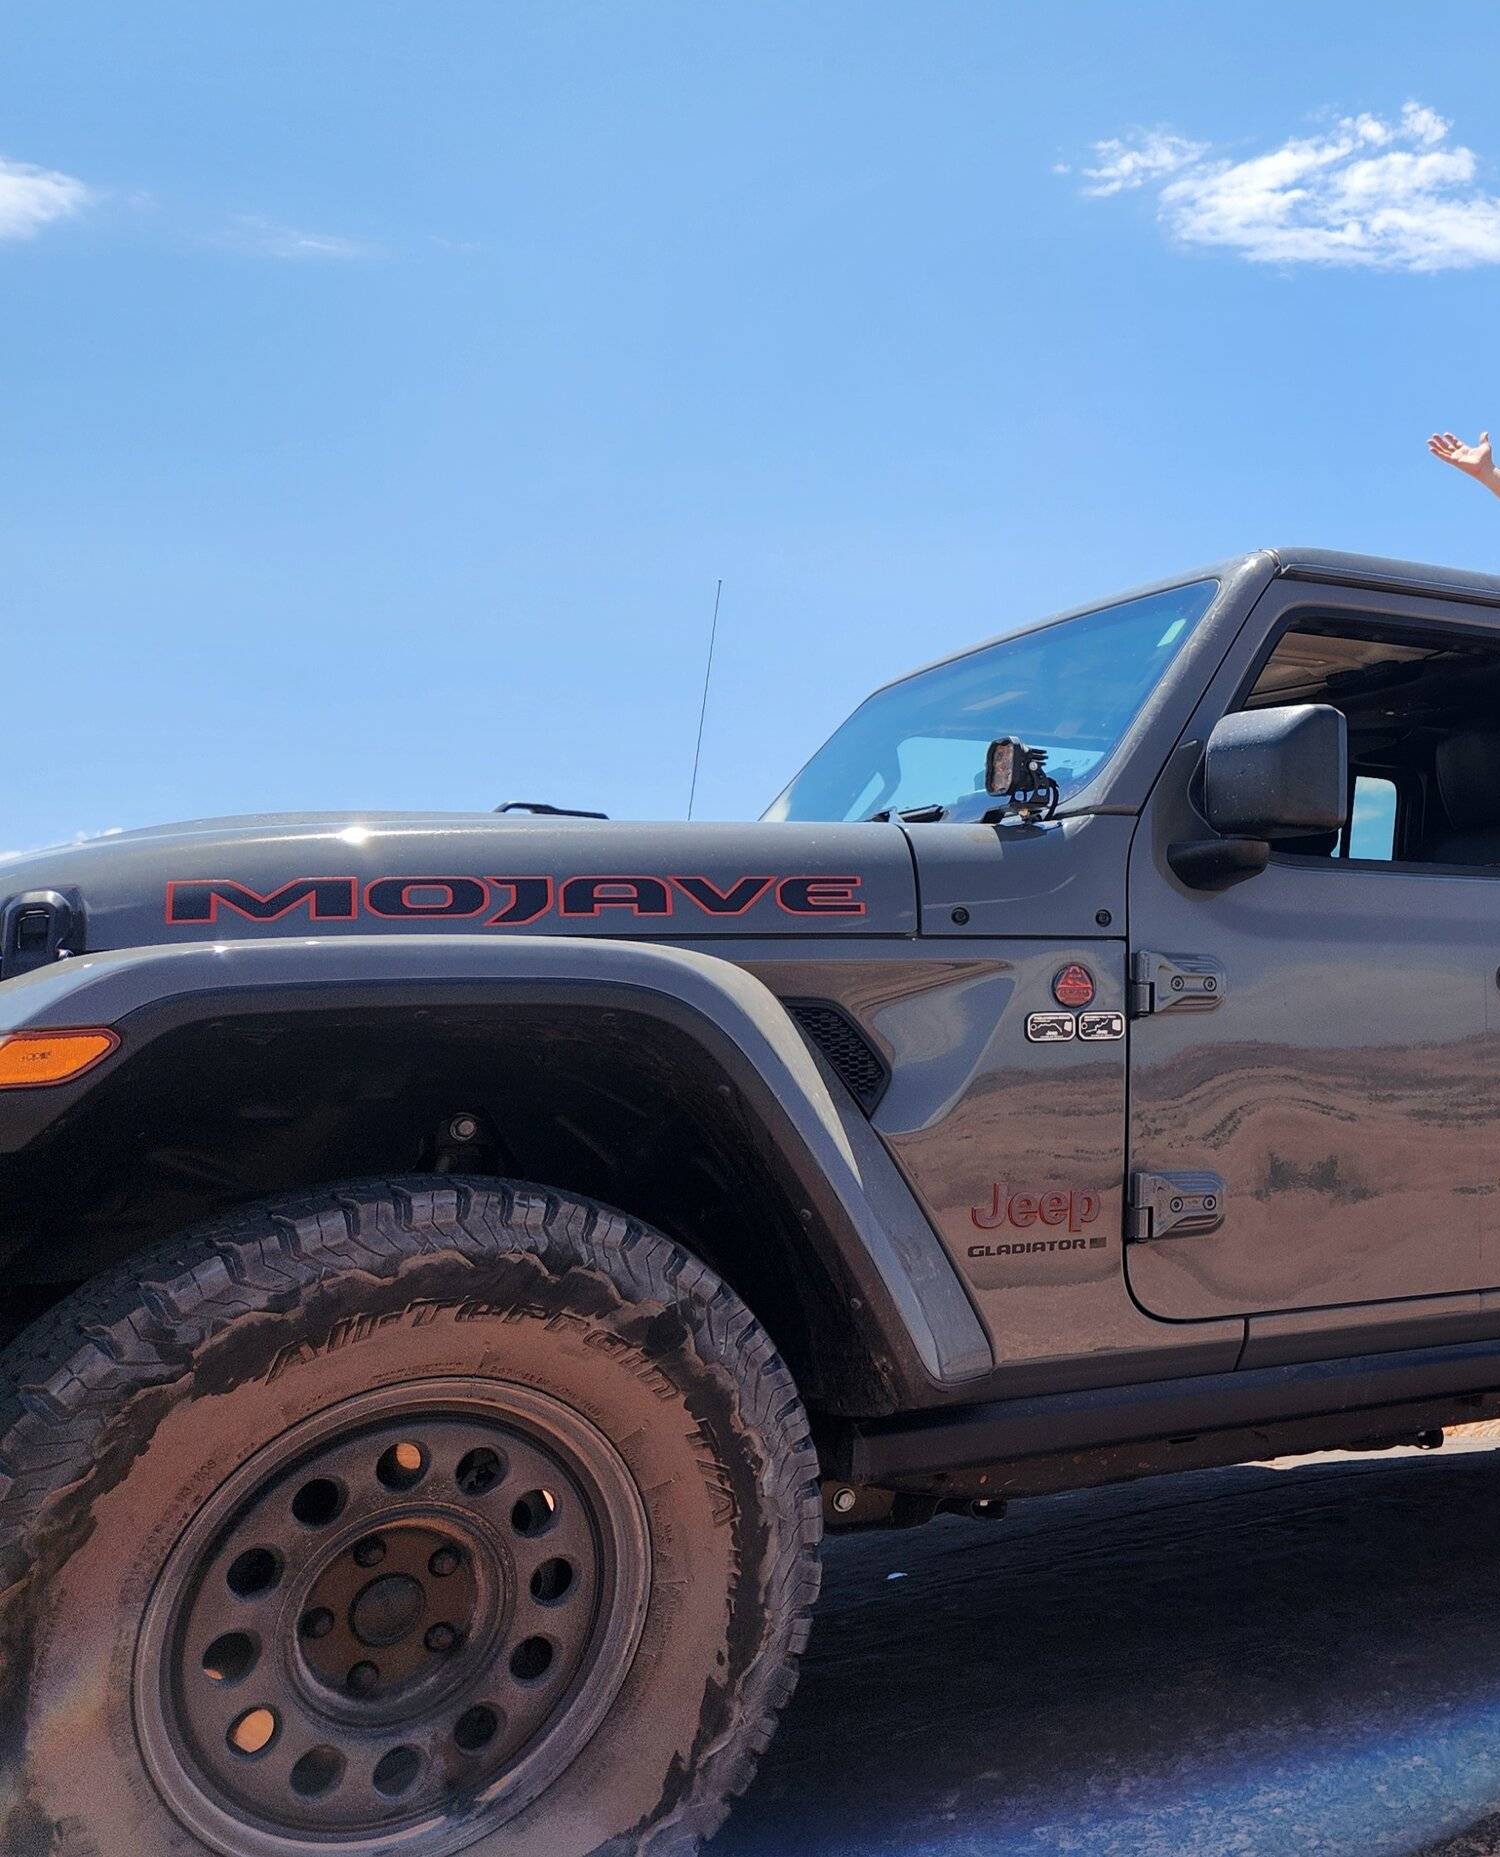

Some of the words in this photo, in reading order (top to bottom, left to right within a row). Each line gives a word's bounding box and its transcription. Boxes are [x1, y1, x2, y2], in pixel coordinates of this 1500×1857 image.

[166, 875, 866, 926] MOJAVE
[971, 1181, 1101, 1233] Jeep
[967, 1239, 1087, 1258] GLADIATOR
